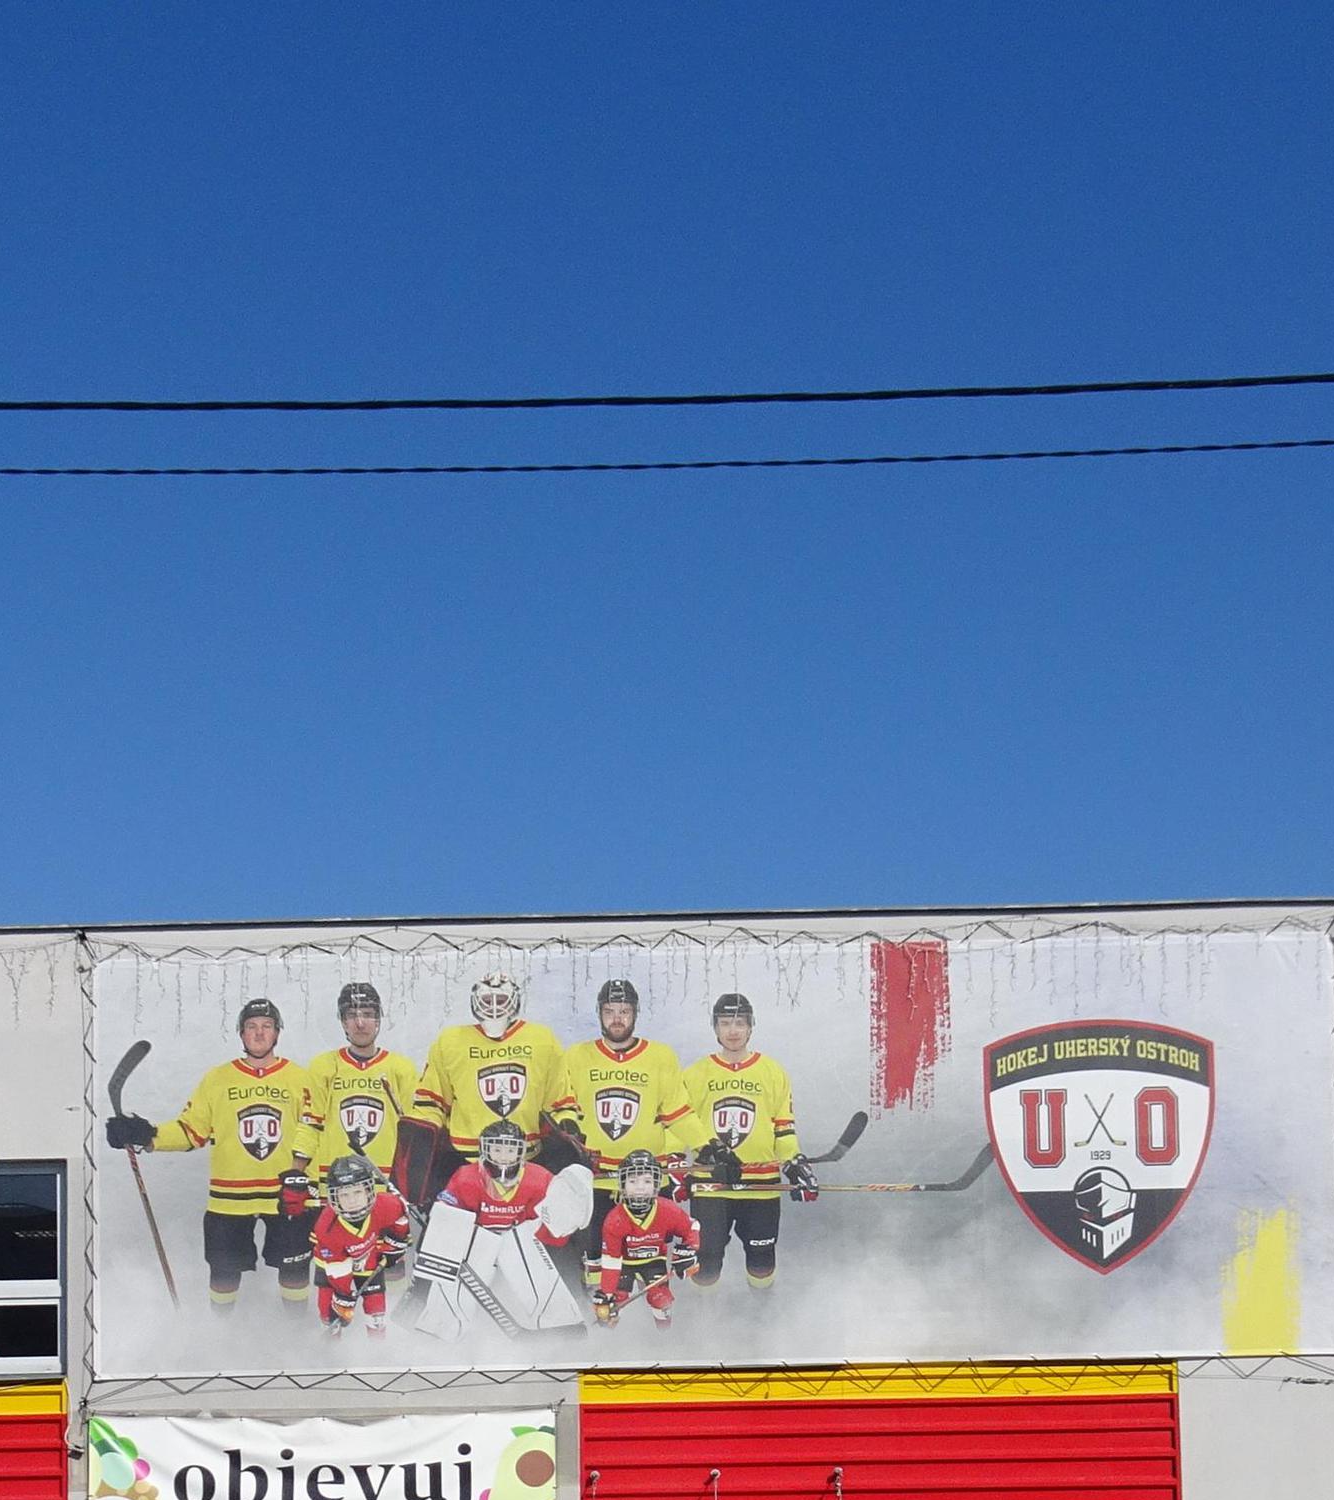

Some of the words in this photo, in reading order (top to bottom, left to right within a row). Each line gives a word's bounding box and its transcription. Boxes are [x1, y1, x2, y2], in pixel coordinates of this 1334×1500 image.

[469, 1045, 532, 1059] Eurotec
[996, 1045, 1049, 1077] HOKEJ
[1054, 1035, 1131, 1060] UHERSKÝ
[1136, 1040, 1201, 1071] OSTROH
[590, 1069, 649, 1083] Eurotec
[333, 1077, 382, 1090] Eurote
[708, 1079, 762, 1092] Eurotec
[228, 1085, 289, 1100] Eurotec
[1020, 1089, 1067, 1168] U
[1135, 1086, 1179, 1165] O
[1090, 1151, 1111, 1160] 1929
